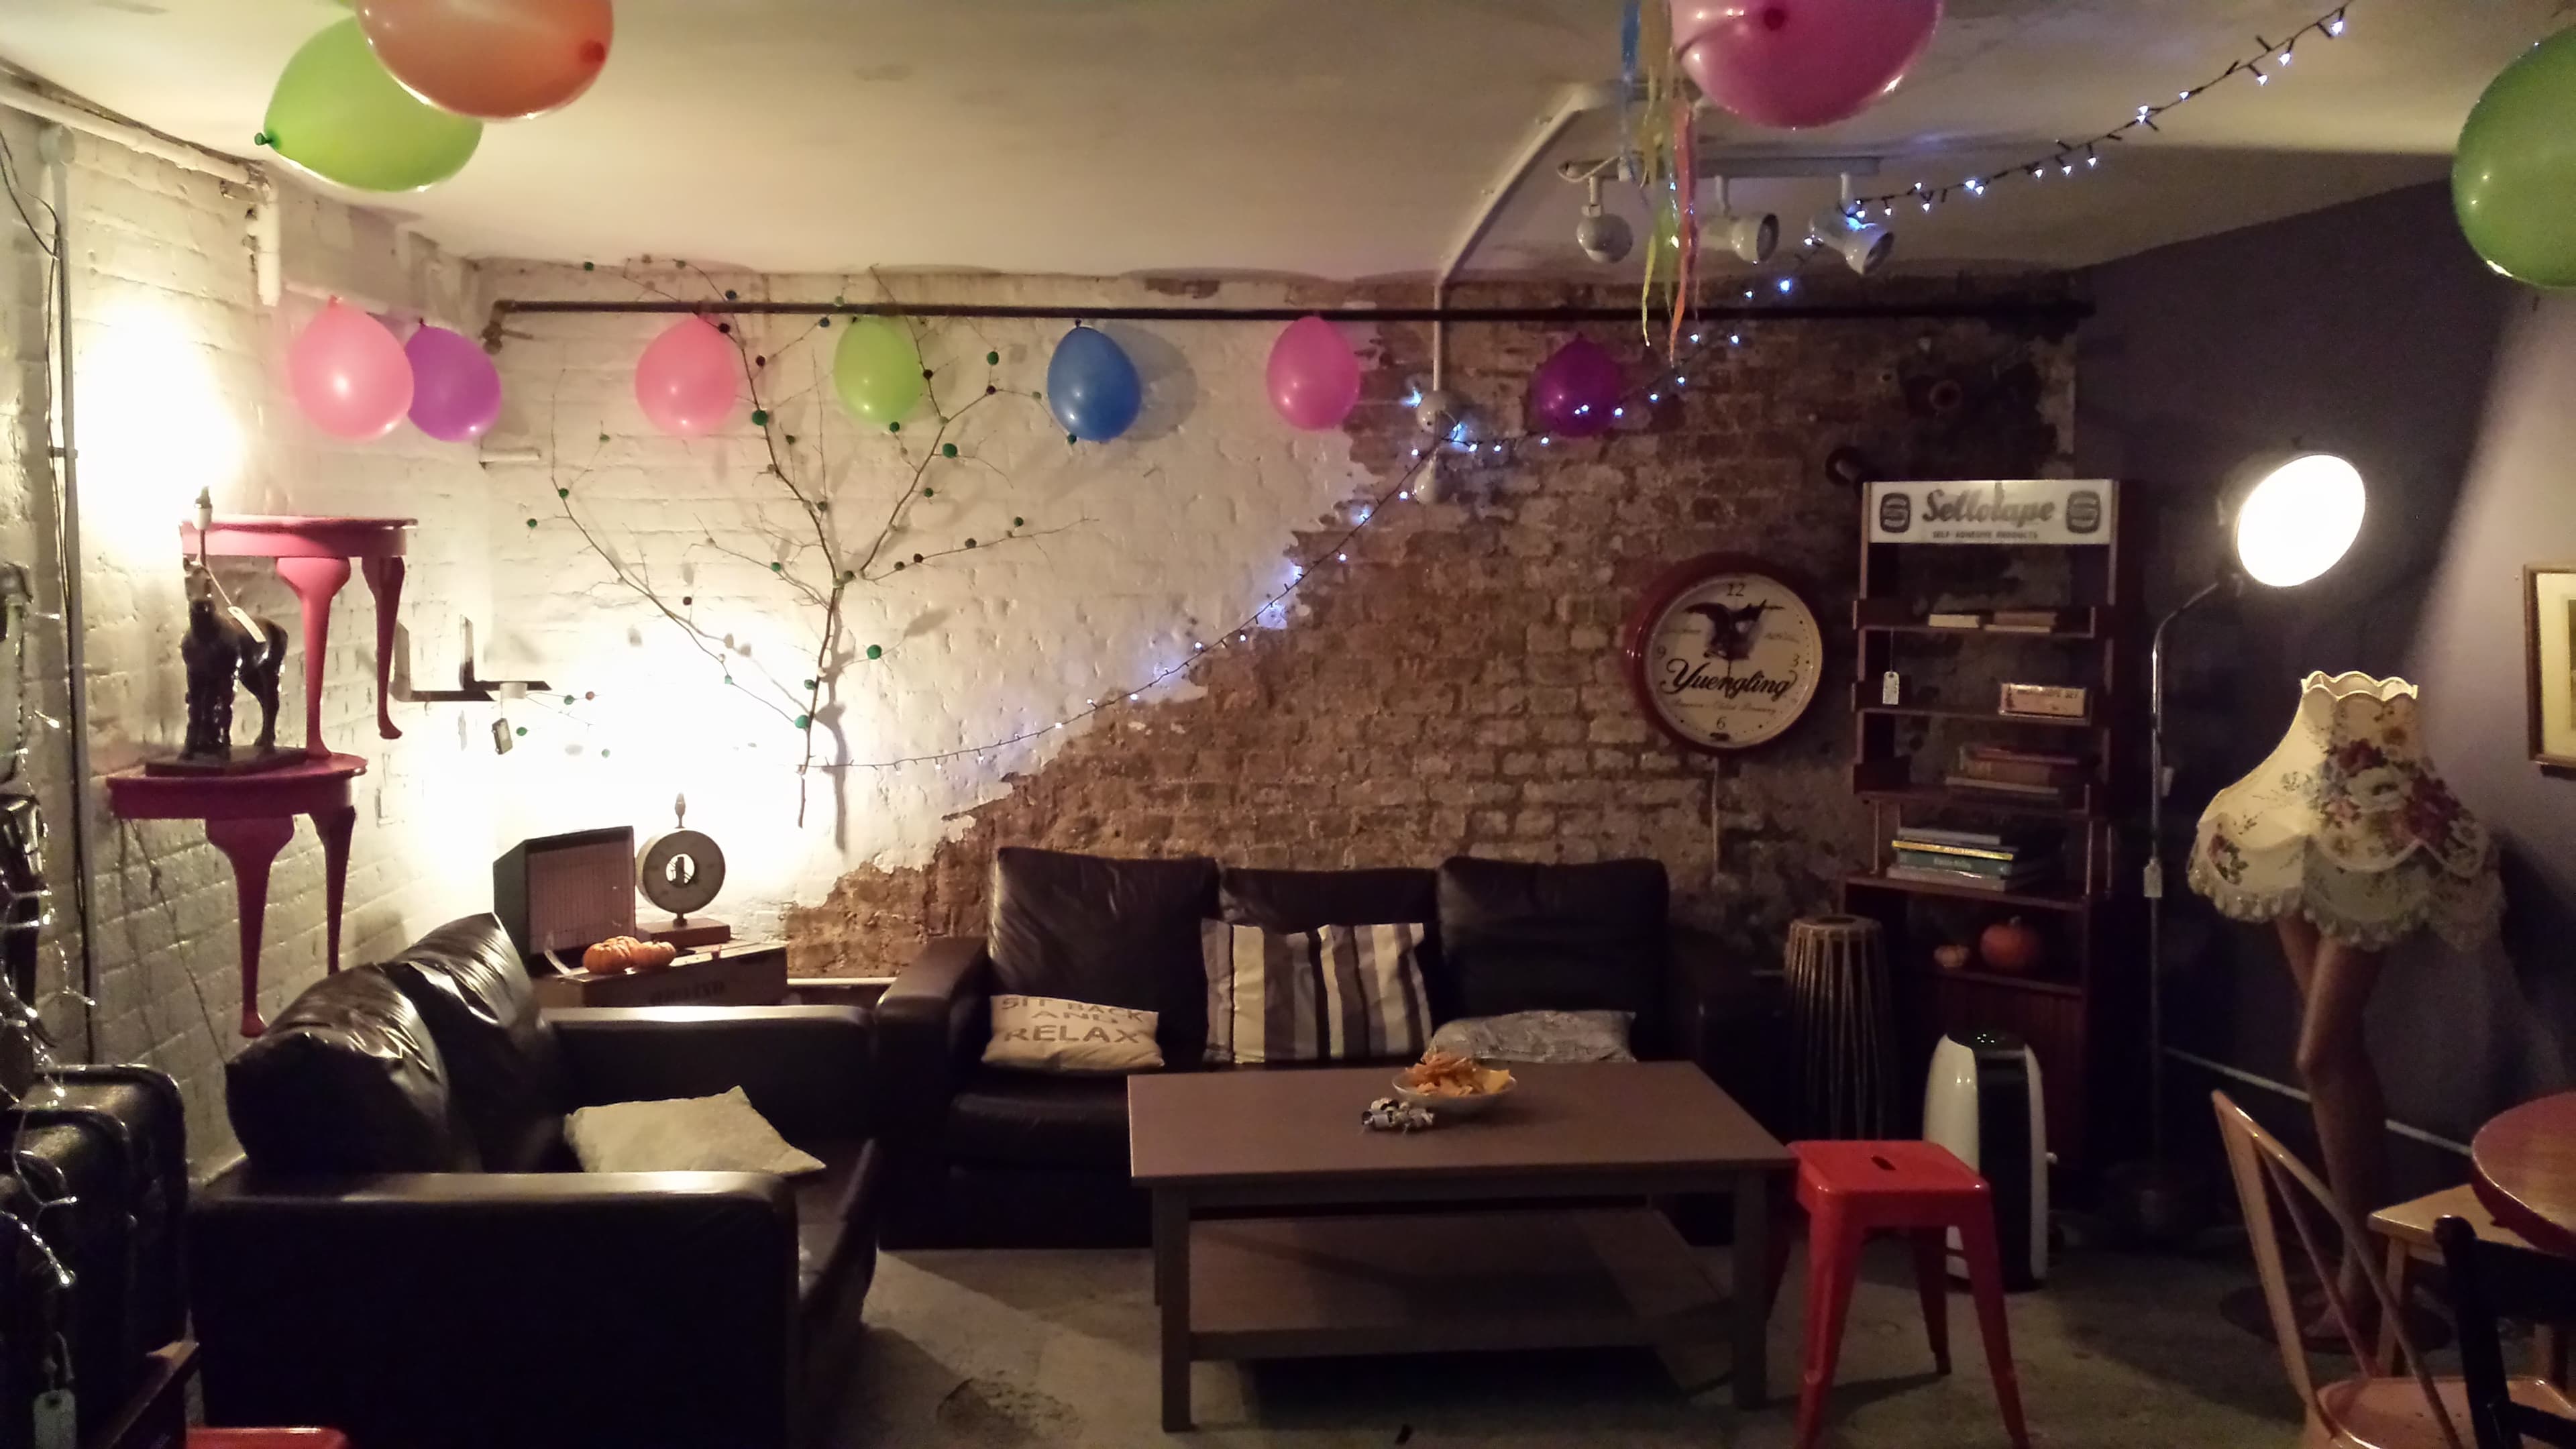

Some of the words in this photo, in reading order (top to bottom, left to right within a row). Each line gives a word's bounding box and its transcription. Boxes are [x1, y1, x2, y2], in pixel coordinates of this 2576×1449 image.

[1922, 483, 2056, 528] Sellotape
[1726, 583, 1746, 596] 12
[1657, 645, 1666, 659] 9
[1791, 654, 1800, 667] 3
[1660, 658, 1798, 702] Yuengling
[1716, 716, 1726, 730] 6
[1004, 1024, 1140, 1044] RELAX
